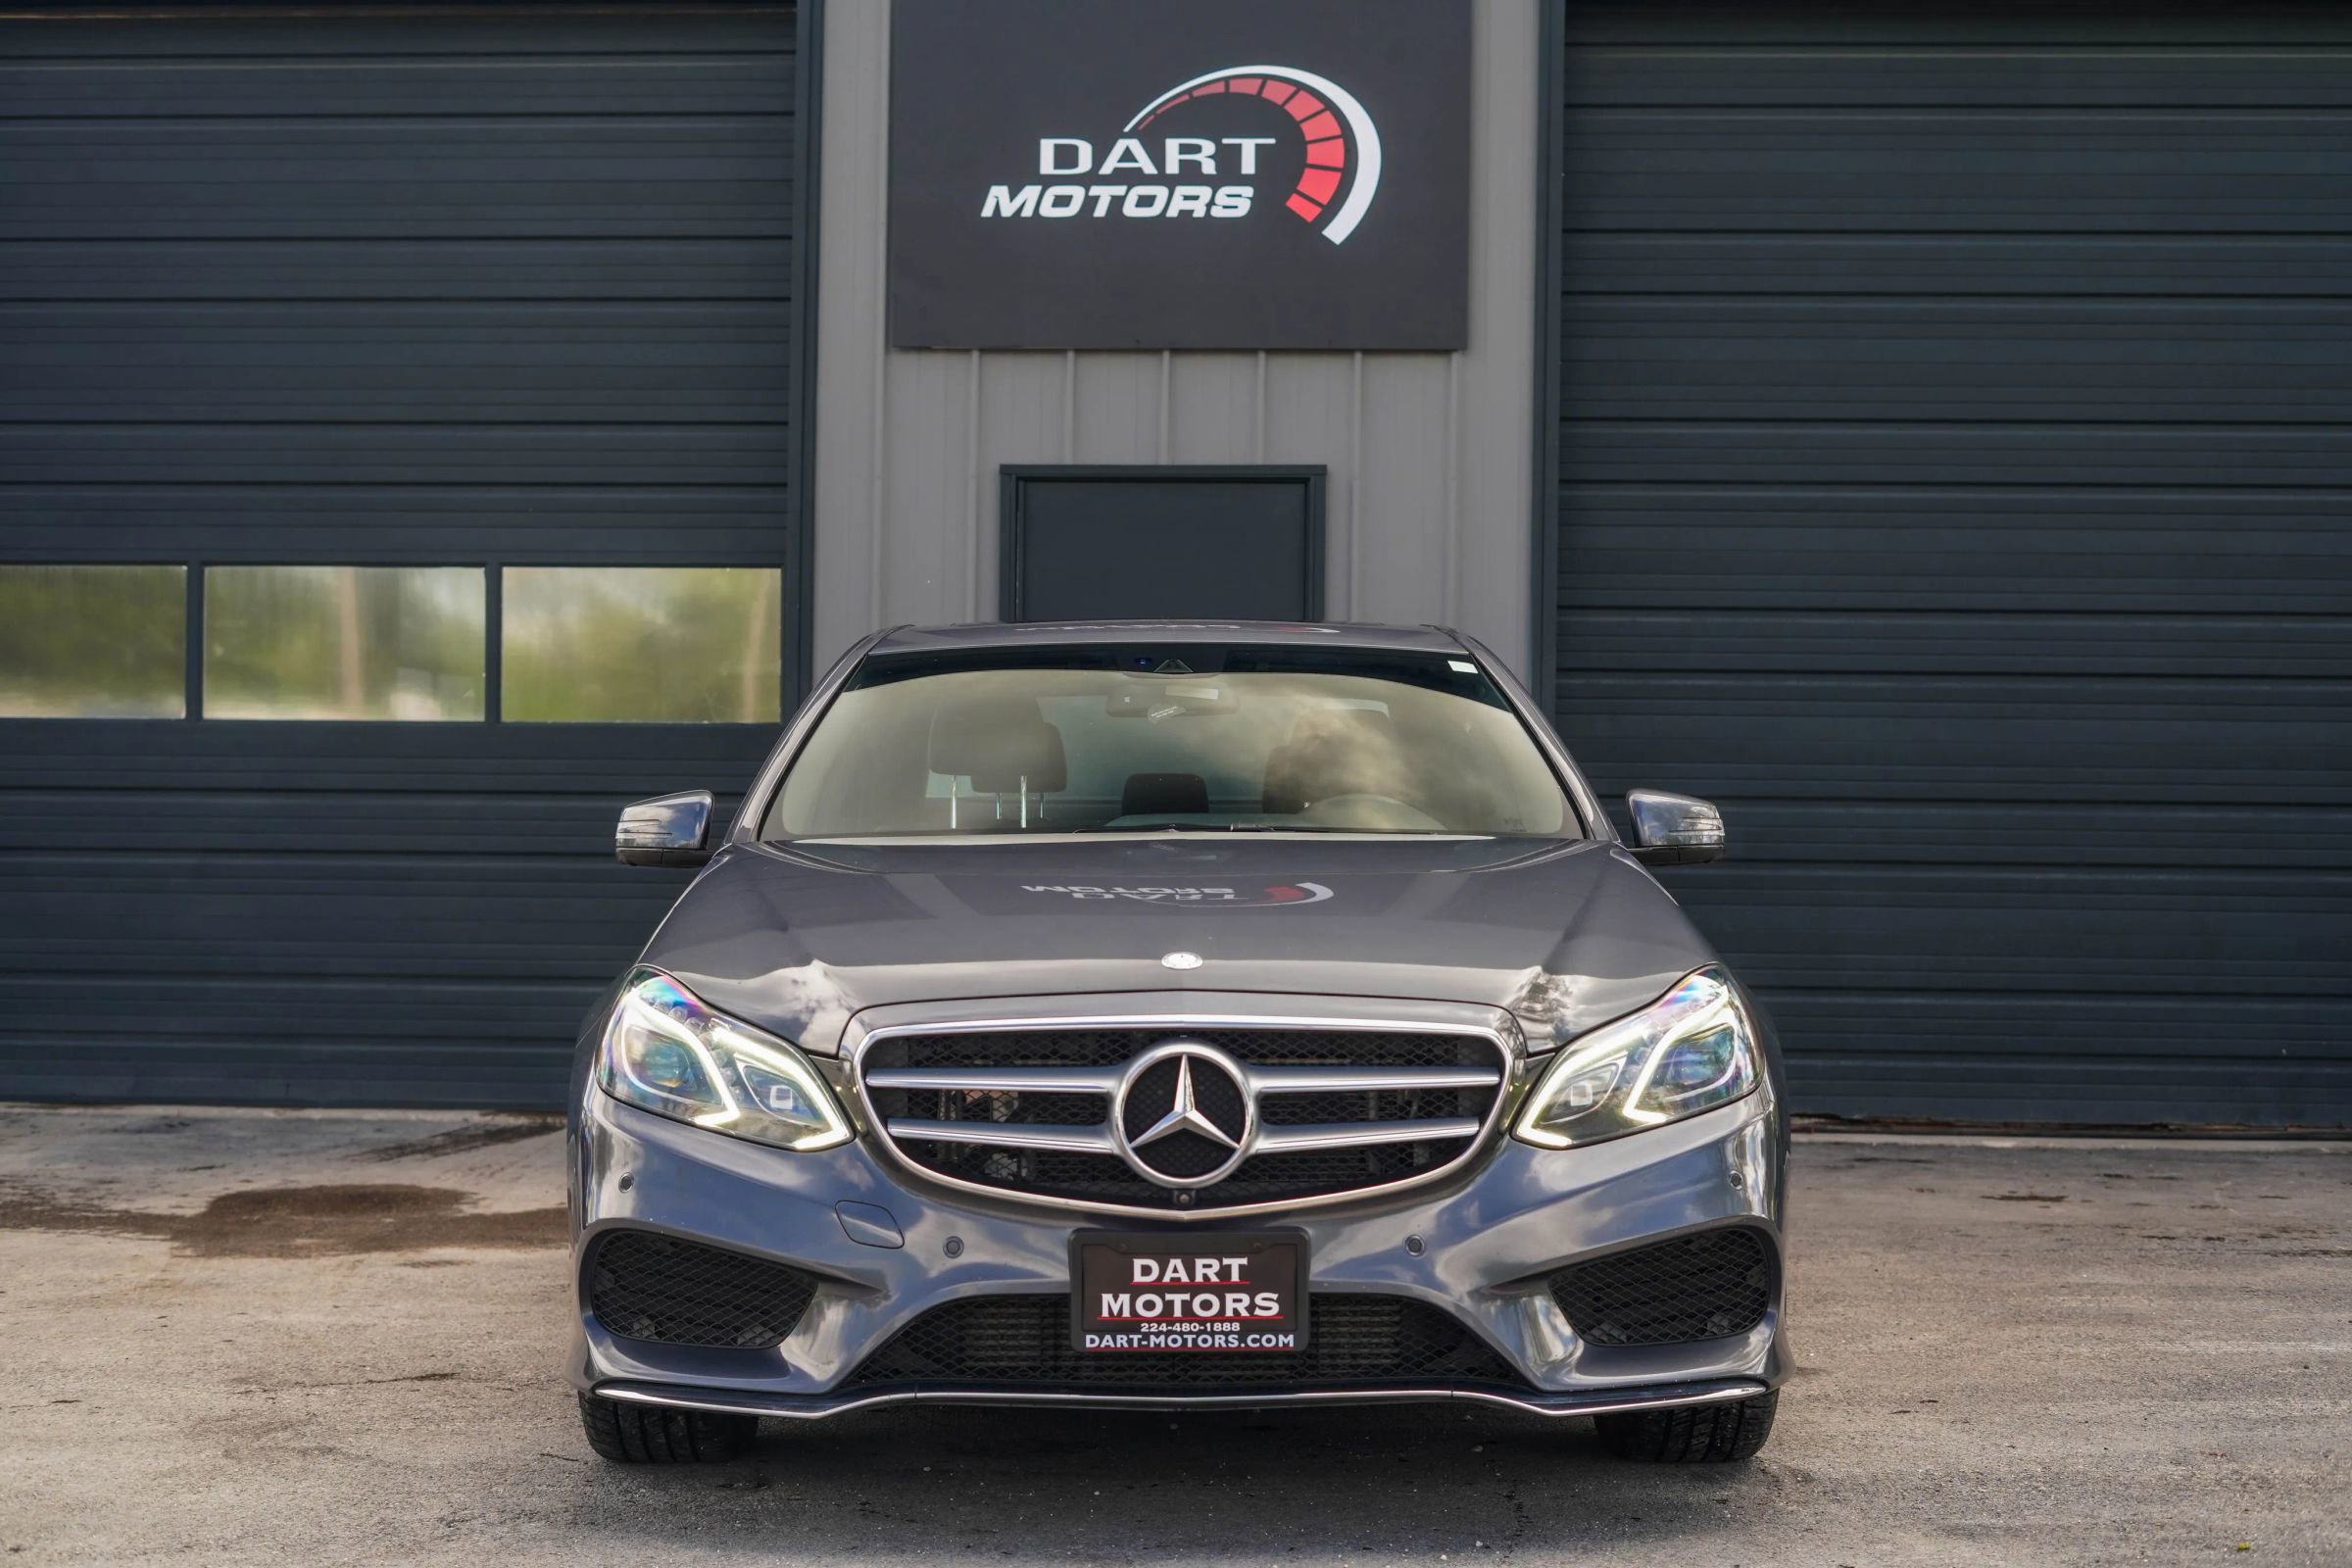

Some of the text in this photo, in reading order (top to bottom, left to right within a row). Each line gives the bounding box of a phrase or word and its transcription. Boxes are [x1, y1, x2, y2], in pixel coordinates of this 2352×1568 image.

[1039, 137, 1276, 175] DART
[980, 184, 1254, 219] MOTORS
[1132, 1256, 1249, 1283] DART
[1101, 1292, 1281, 1318] MOTORS
[1085, 1333, 1295, 1348] DART-MOTORS.COM
[1140, 1322, 1241, 1333] 224-480-1888
